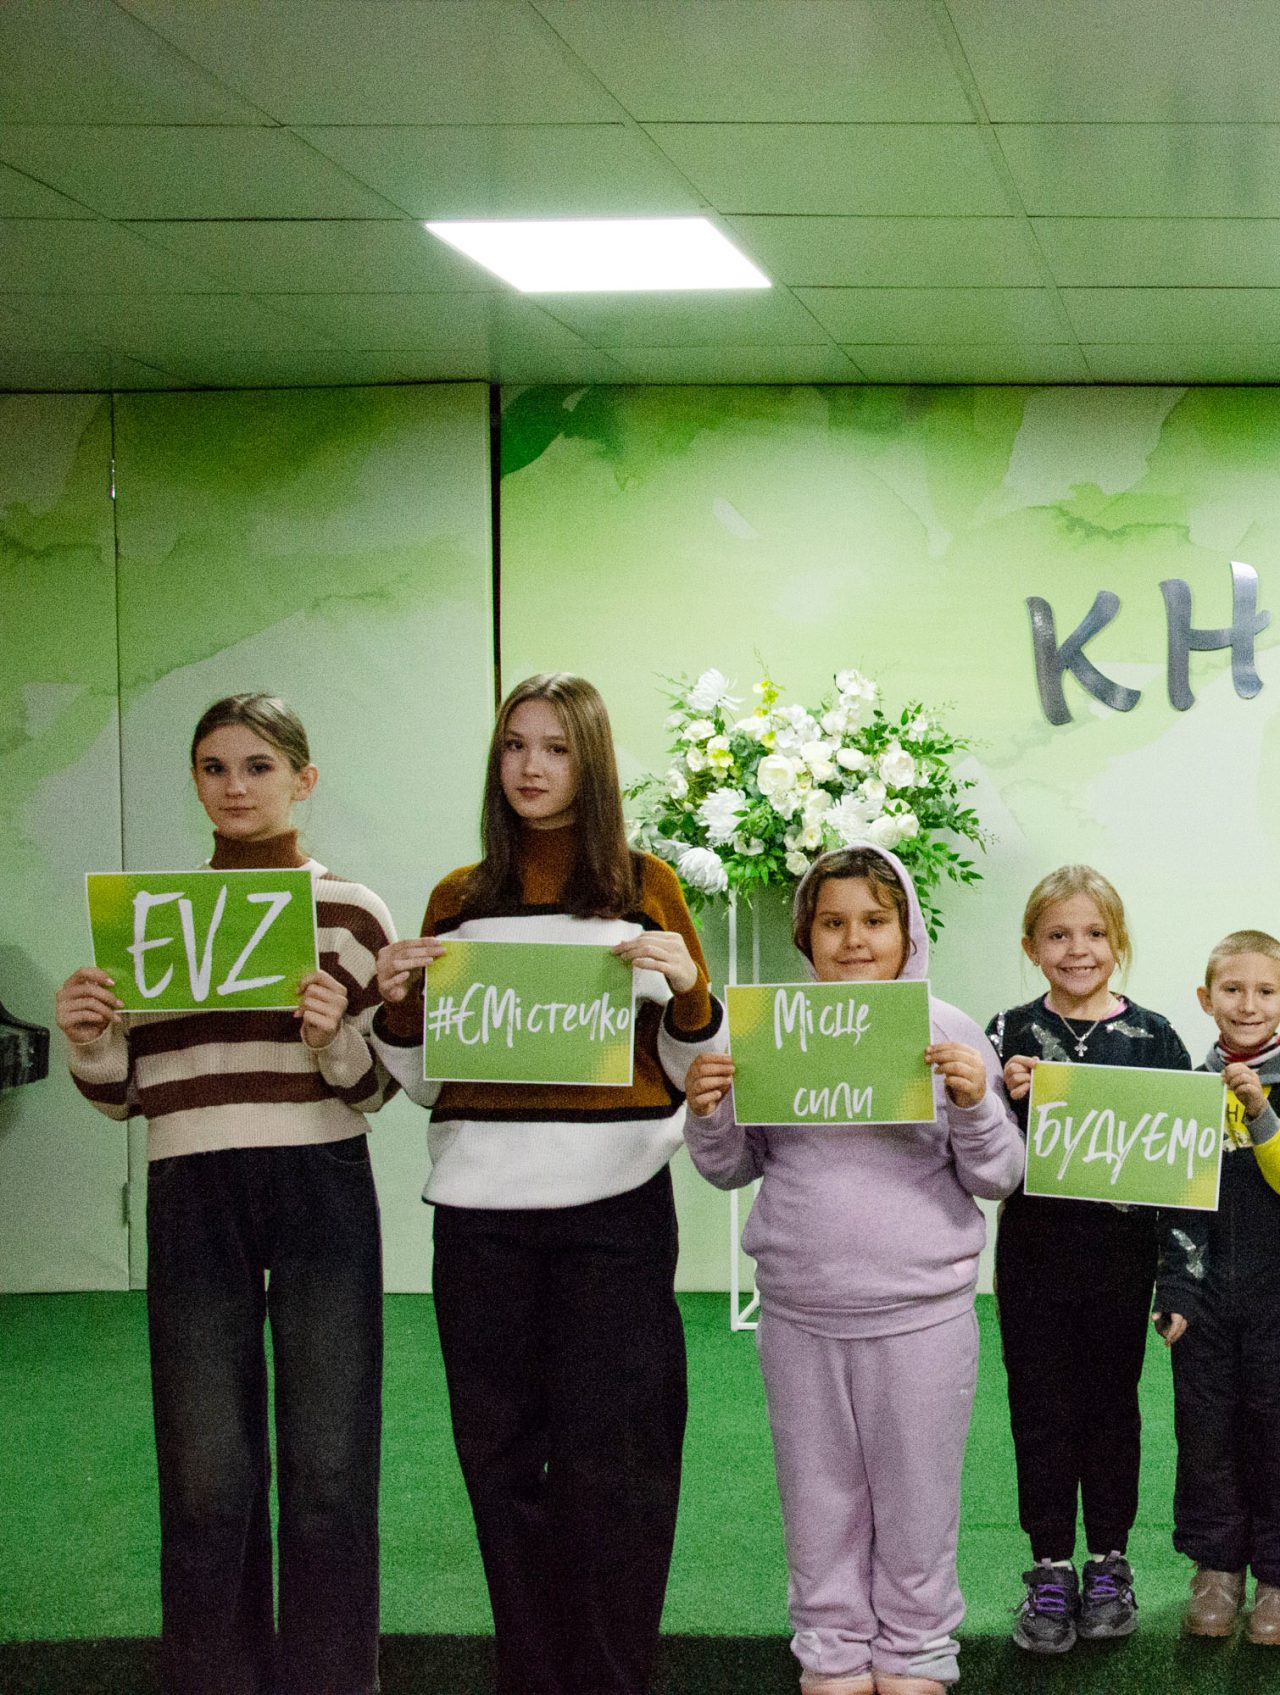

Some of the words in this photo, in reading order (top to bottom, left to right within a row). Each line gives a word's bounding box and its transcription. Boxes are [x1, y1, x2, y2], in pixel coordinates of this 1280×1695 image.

[127, 885, 292, 1001] EVZ
[773, 988, 872, 1053] Місце
[793, 1082, 873, 1119] сили
